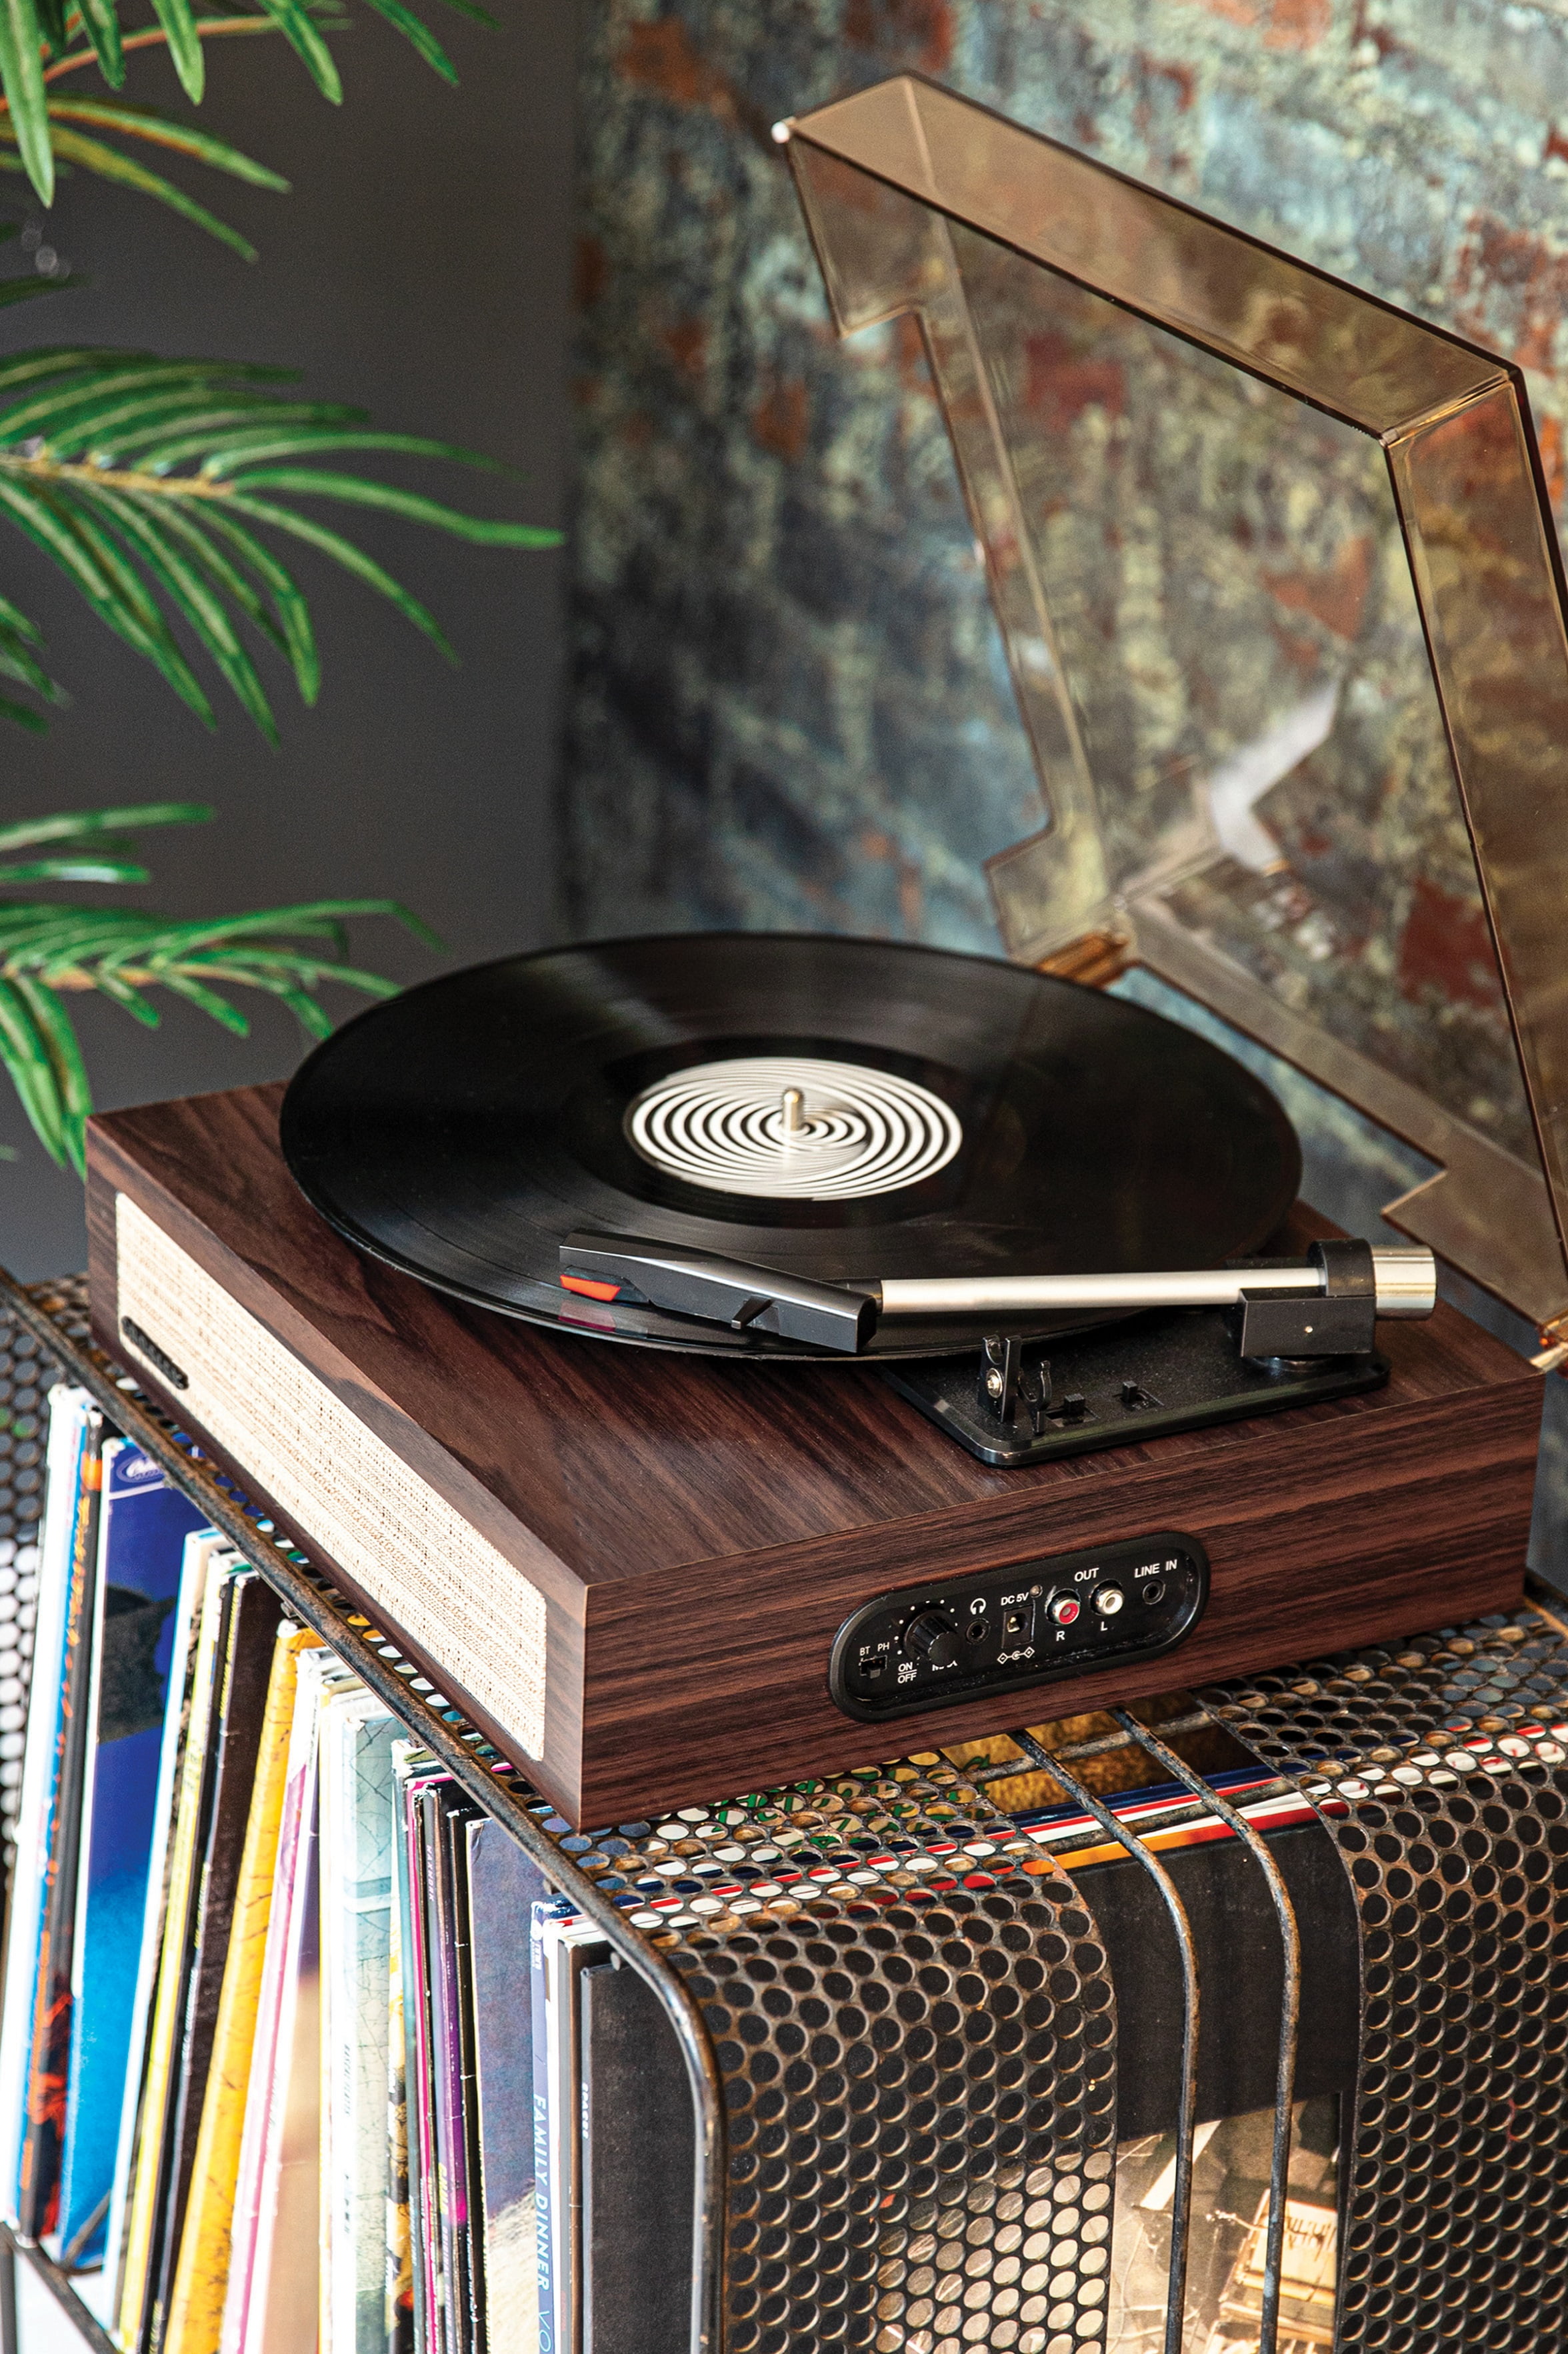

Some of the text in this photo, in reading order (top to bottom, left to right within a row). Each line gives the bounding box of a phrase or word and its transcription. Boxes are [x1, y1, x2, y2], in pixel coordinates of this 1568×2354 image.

[1074, 1567, 1099, 1582] OUT
[1134, 1559, 1177, 1578] LINE IN
[1001, 1592, 1029, 1606] DC 5V
[1101, 1621, 1108, 1631] L
[1056, 1630, 1065, 1641] R
[859, 1641, 890, 1656] BT PH
[898, 1661, 913, 1672] ON
[897, 1672, 917, 1684] OFF
[533, 2093, 547, 2186] FAMILY
[535, 2192, 550, 2291] DINNER
